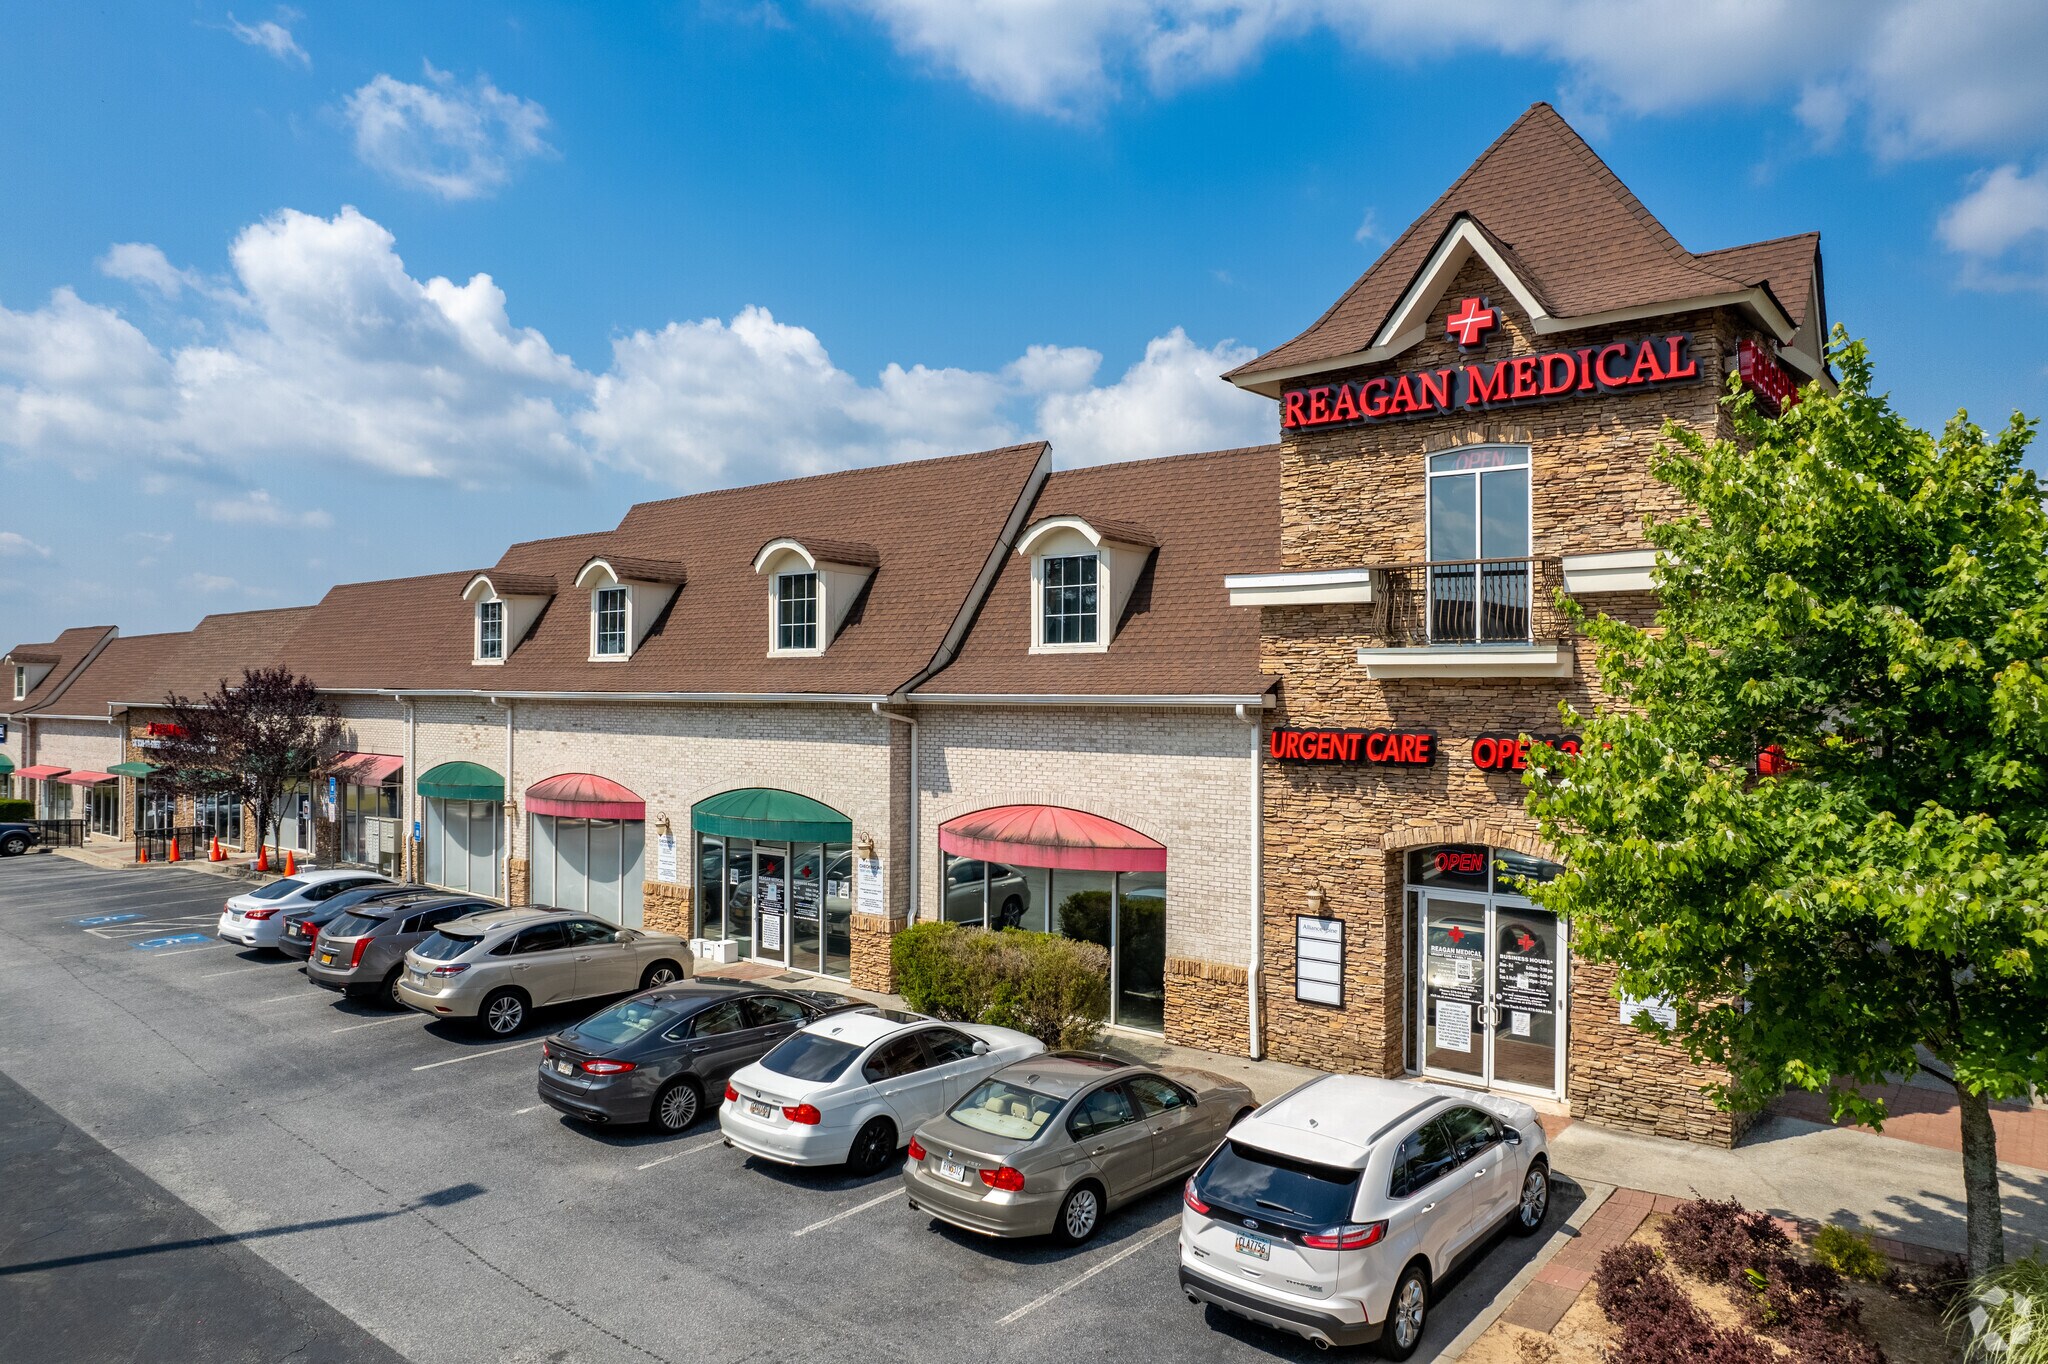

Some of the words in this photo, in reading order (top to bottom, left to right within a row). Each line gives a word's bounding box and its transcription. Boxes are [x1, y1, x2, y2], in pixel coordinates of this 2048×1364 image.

[1283, 369, 1455, 429] REAGAN
[1464, 335, 1697, 405] MEDICAL
[1455, 449, 1506, 471] OPEN
[1270, 731, 1363, 761] URGENT
[1366, 733, 1430, 763] CARE
[1472, 737, 1555, 770] OPE
[1434, 852, 1484, 872] OPEN
[1430, 945, 1455, 954] REAGAN
[1455, 948, 1482, 957] MEDICAL
[1499, 954, 1529, 962] BUSINESS
[1239, 1236, 1266, 1254] CLA7756
